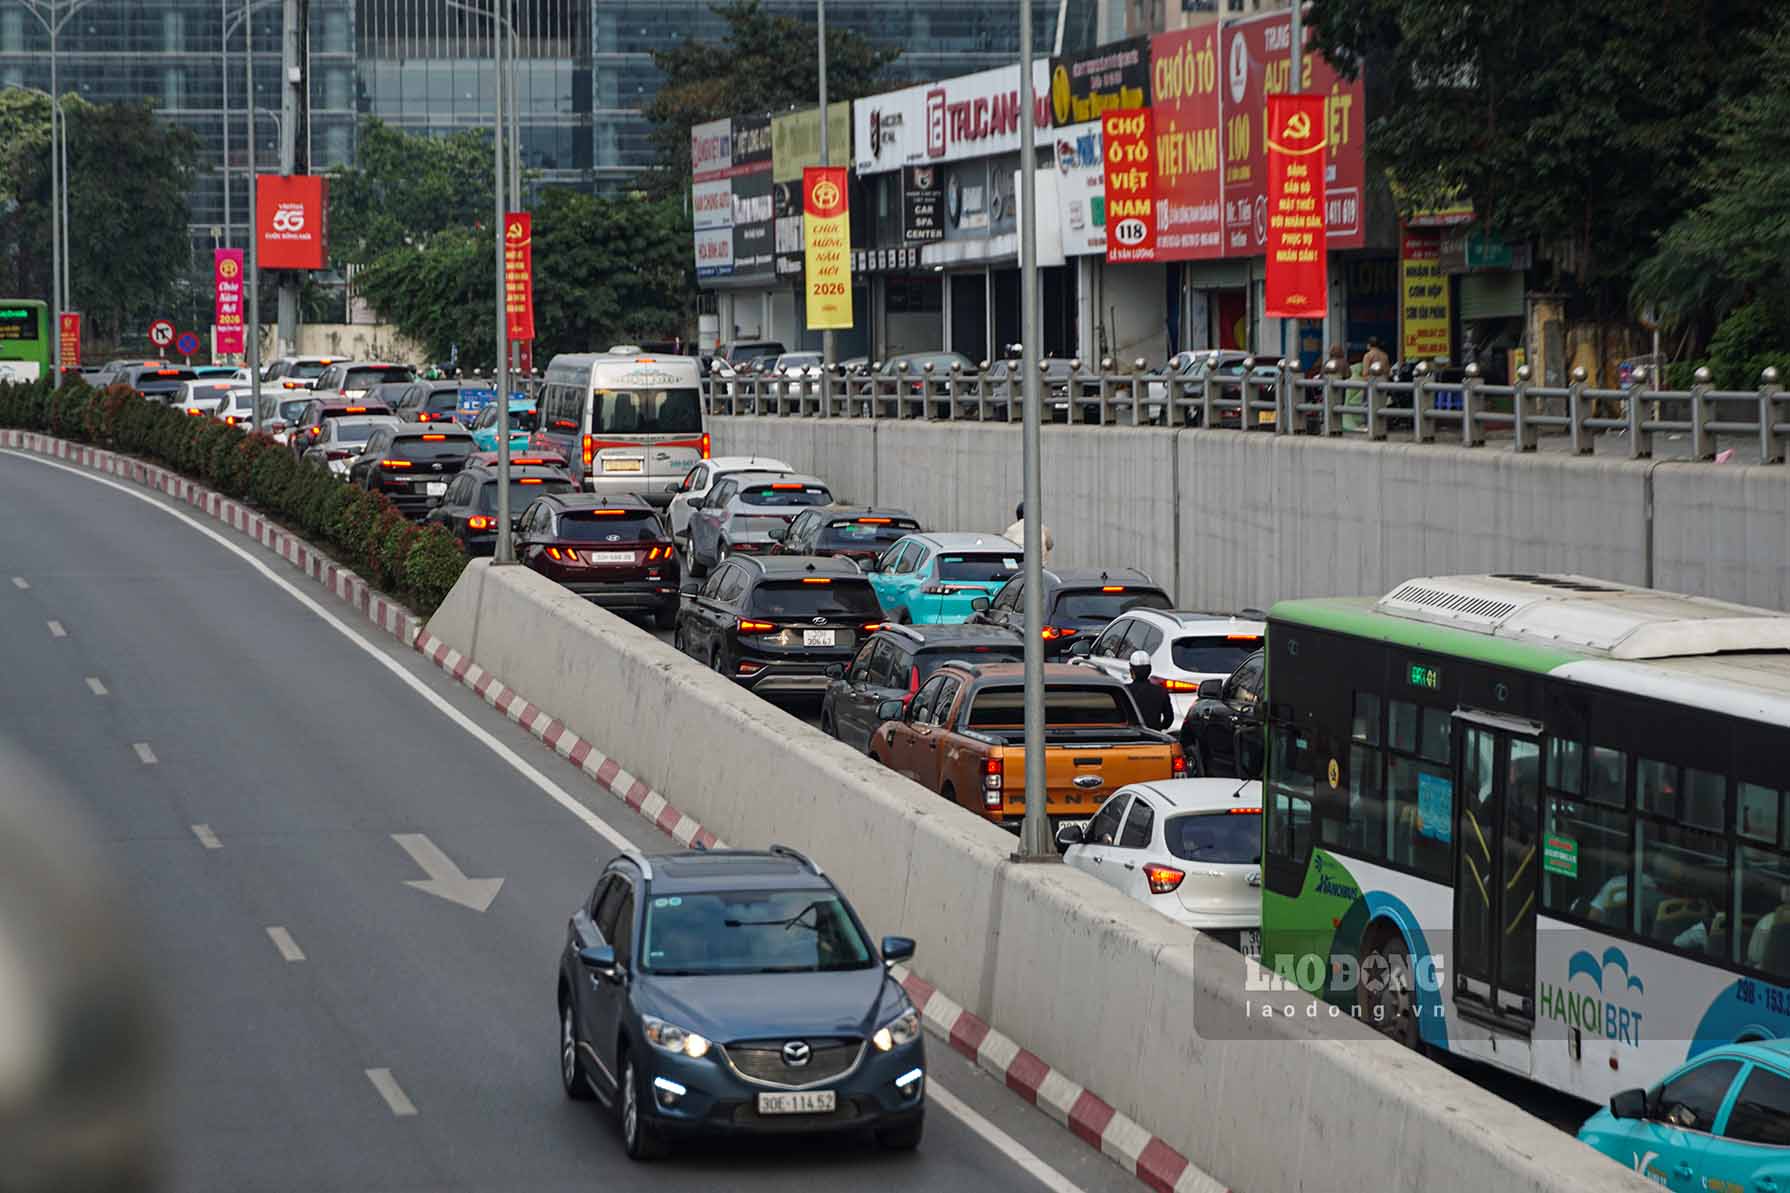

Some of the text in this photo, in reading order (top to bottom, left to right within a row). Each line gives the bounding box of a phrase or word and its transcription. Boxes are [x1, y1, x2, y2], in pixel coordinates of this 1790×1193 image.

[1155, 45, 1184, 112] CHỢ
[1184, 39, 1196, 97] Ô
[1197, 35, 1216, 94] TÔ
[1264, 59, 1293, 94] AUT
[1107, 113, 1146, 139] CHỢ
[1227, 113, 1250, 161] 100
[1109, 140, 1124, 163] Ô
[1125, 140, 1149, 163] TÔ
[1157, 120, 1185, 187] VIỆT
[1186, 128, 1217, 174] NAM
[1110, 167, 1150, 193] VIỆT
[914, 206, 934, 215] CAR
[1110, 198, 1151, 218] NAM
[273, 210, 305, 232] 5G
[915, 218, 934, 227] SPA
[1119, 223, 1143, 239] 118
[906, 229, 943, 239] CENTER
[813, 283, 845, 295] 2026
[1540, 981, 1643, 1048] HANOI BRT
